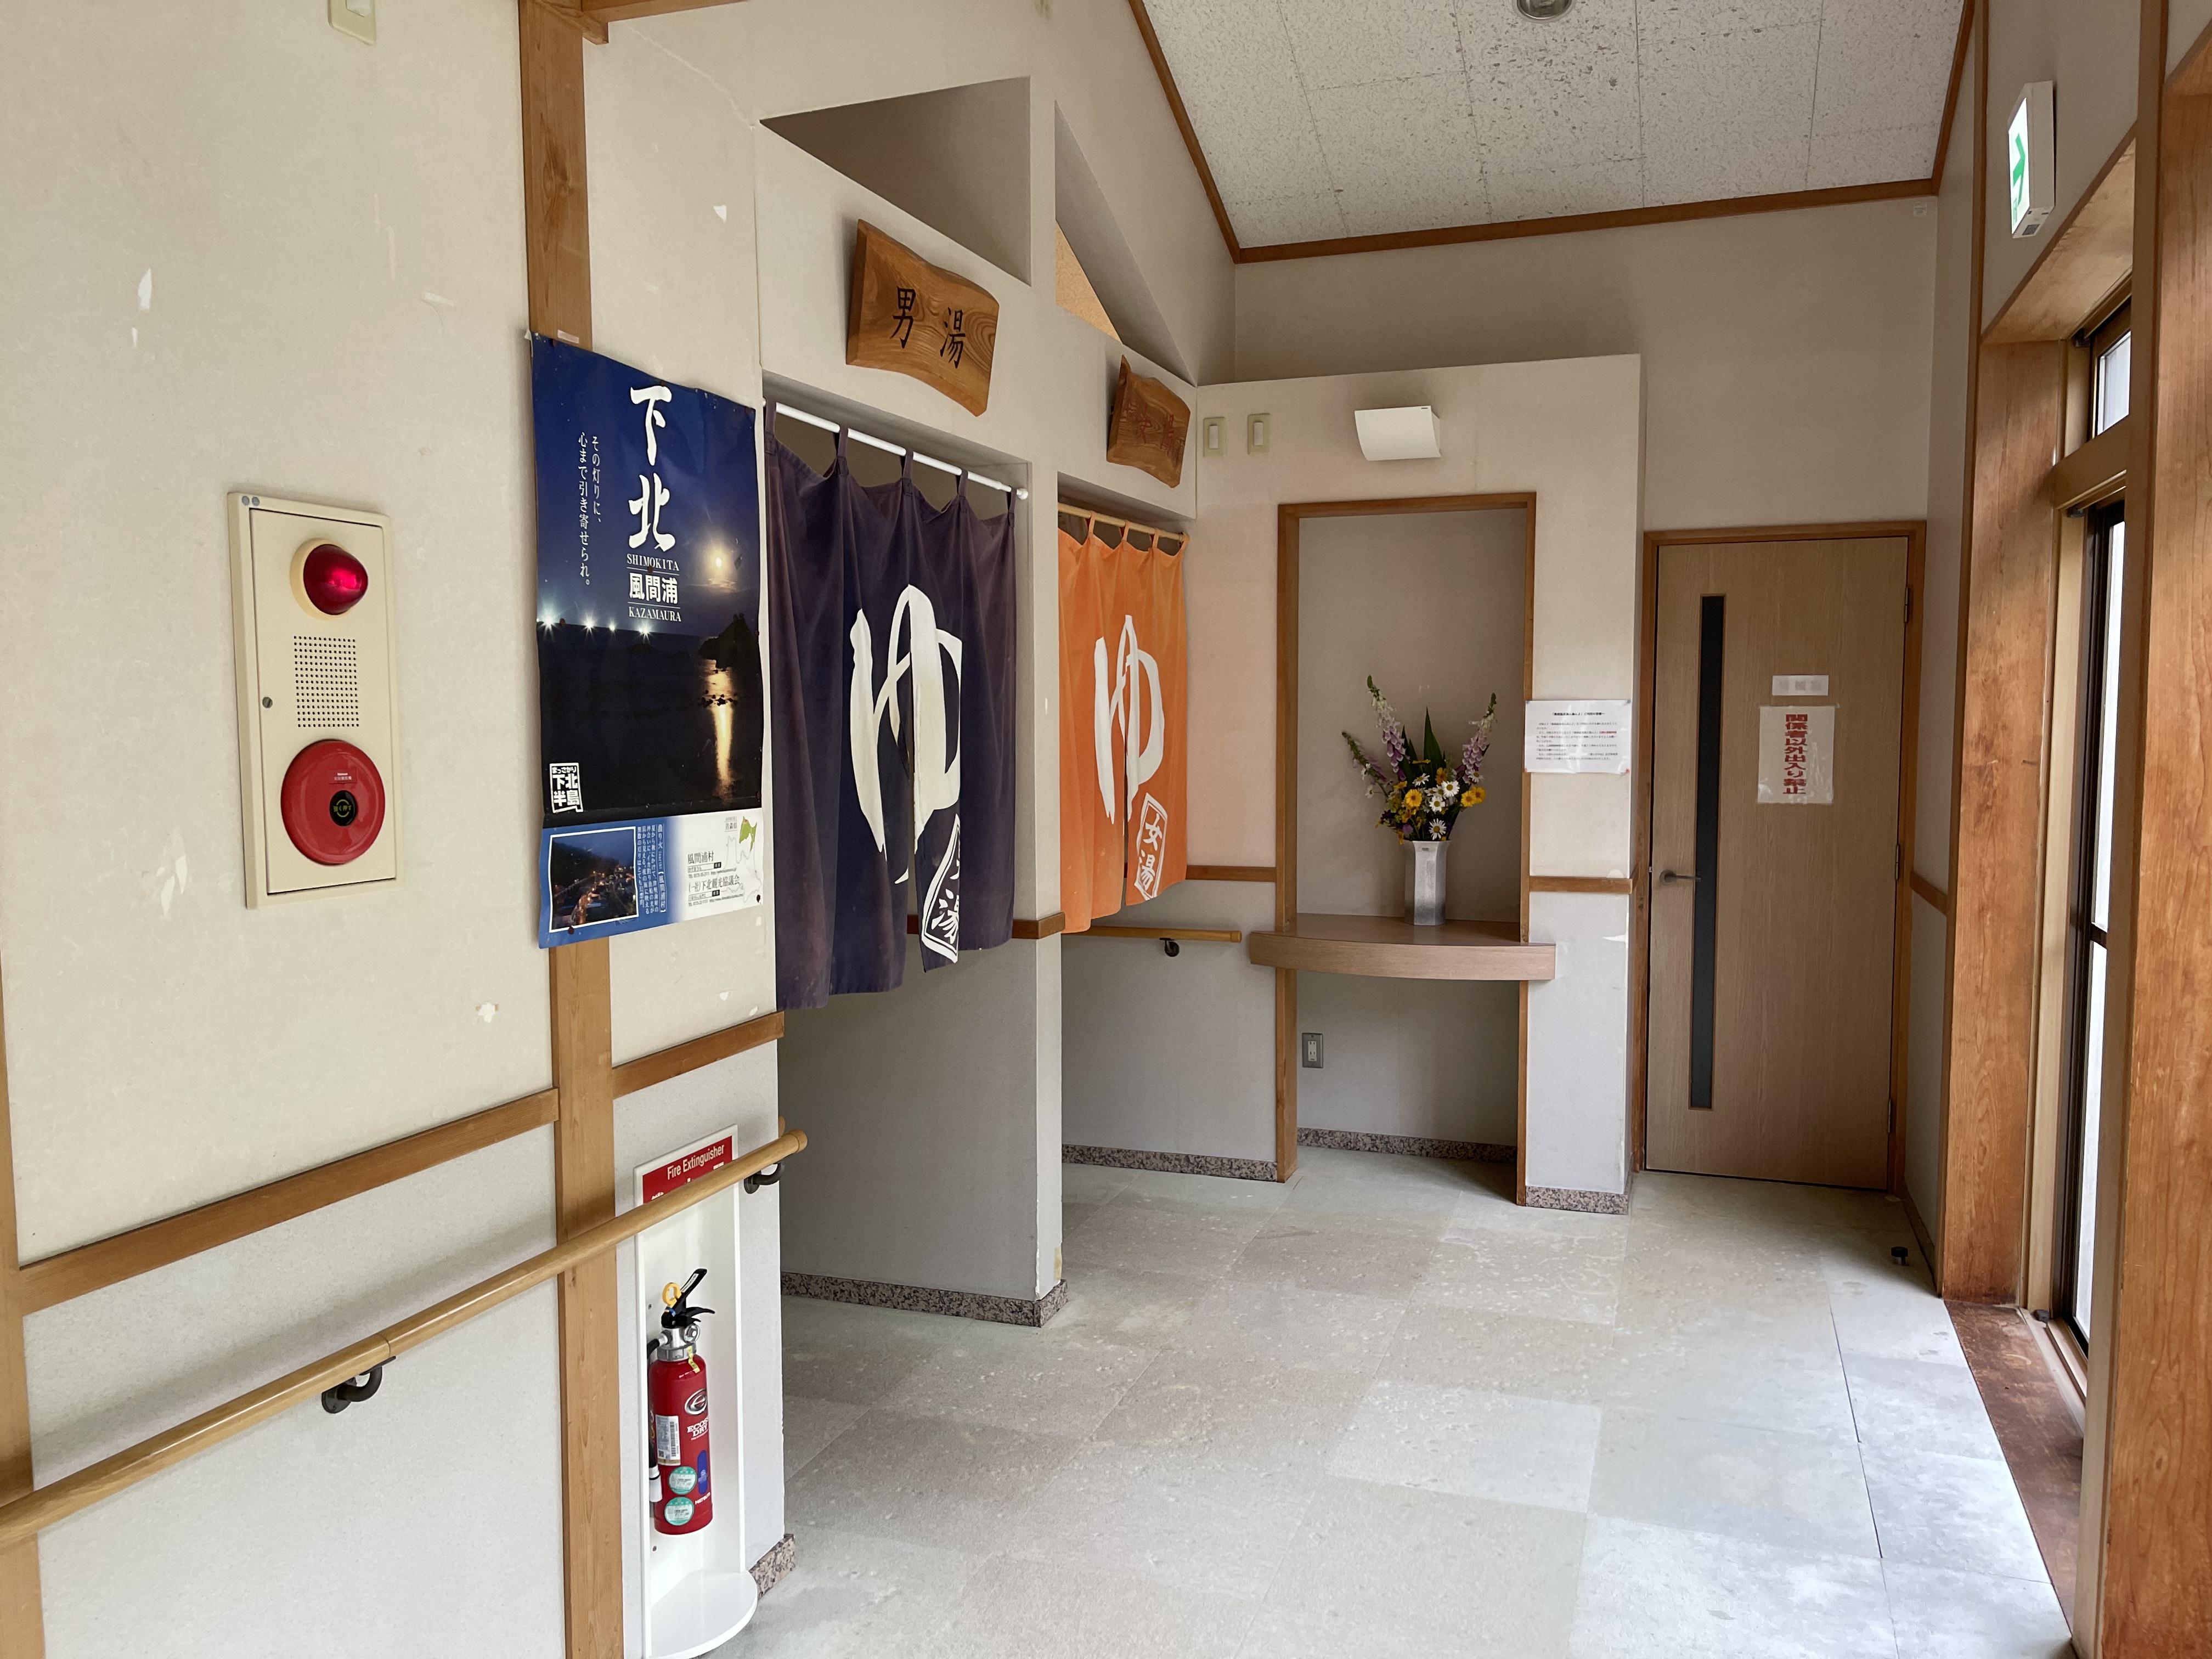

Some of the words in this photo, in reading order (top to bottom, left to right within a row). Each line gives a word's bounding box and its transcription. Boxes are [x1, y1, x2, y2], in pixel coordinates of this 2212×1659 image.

[889, 286, 966, 369] 男湯
[592, 436, 601, 523] その灯りに、
[629, 385, 676, 552] 下北
[578, 432, 590, 585] 心まで引き寄せられ。
[627, 553, 680, 571] SHIMOKITA
[629, 573, 678, 604] 風間浦
[628, 606, 681, 622] KAZAMAURA
[850, 584, 962, 861] ゆ
[1093, 614, 1165, 825] ゆ
[552, 773, 579, 790] 下北
[554, 790, 580, 806] 半島
[687, 850, 714, 864] 風間浦村
[1138, 812, 1163, 891] 女湯
[667, 1165, 681, 1180] Fire
[683, 1144, 725, 1172] Extinguisher
